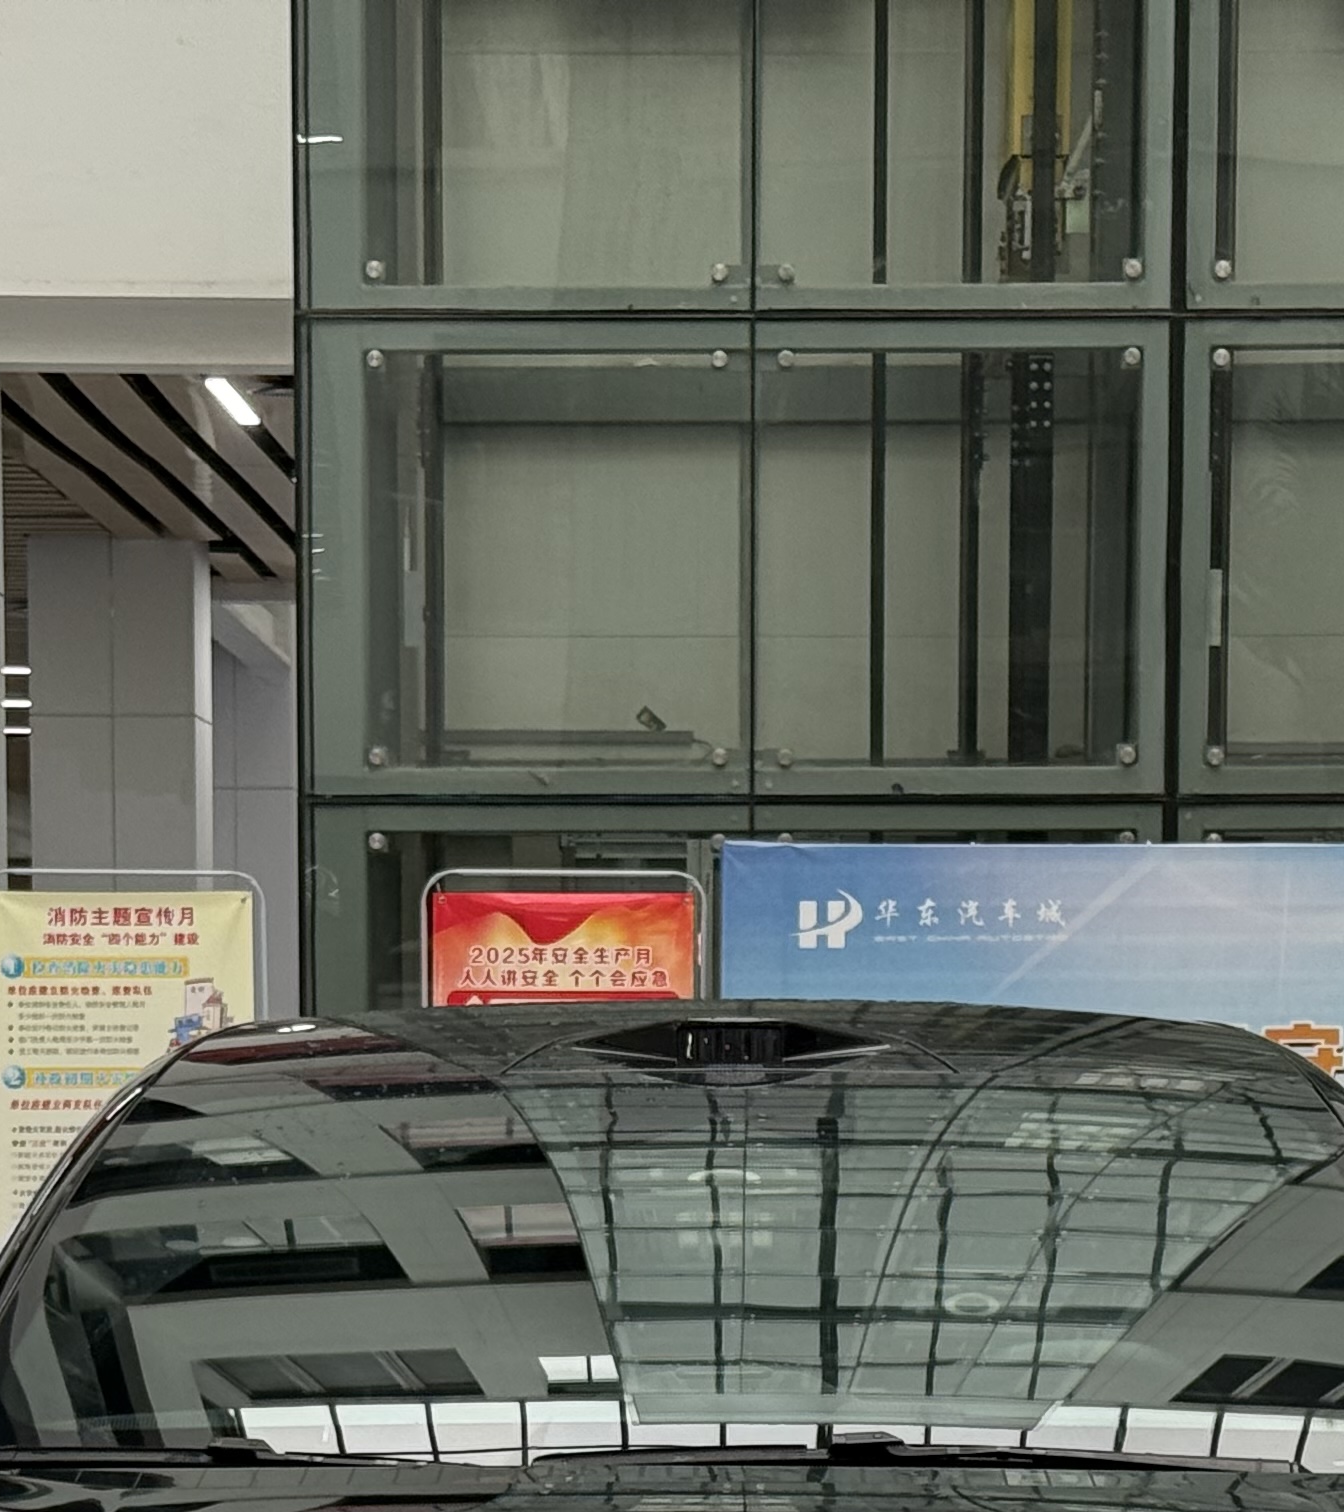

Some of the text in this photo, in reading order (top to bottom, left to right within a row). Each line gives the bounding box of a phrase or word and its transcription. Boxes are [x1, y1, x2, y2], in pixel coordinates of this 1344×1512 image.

[47, 906, 195, 927] 消防主题宣传月
[874, 899, 1066, 928] 华东汽车城
[470, 946, 652, 966] 2025年安全生产月
[459, 969, 670, 989] 人人讲安全 个个会应急
